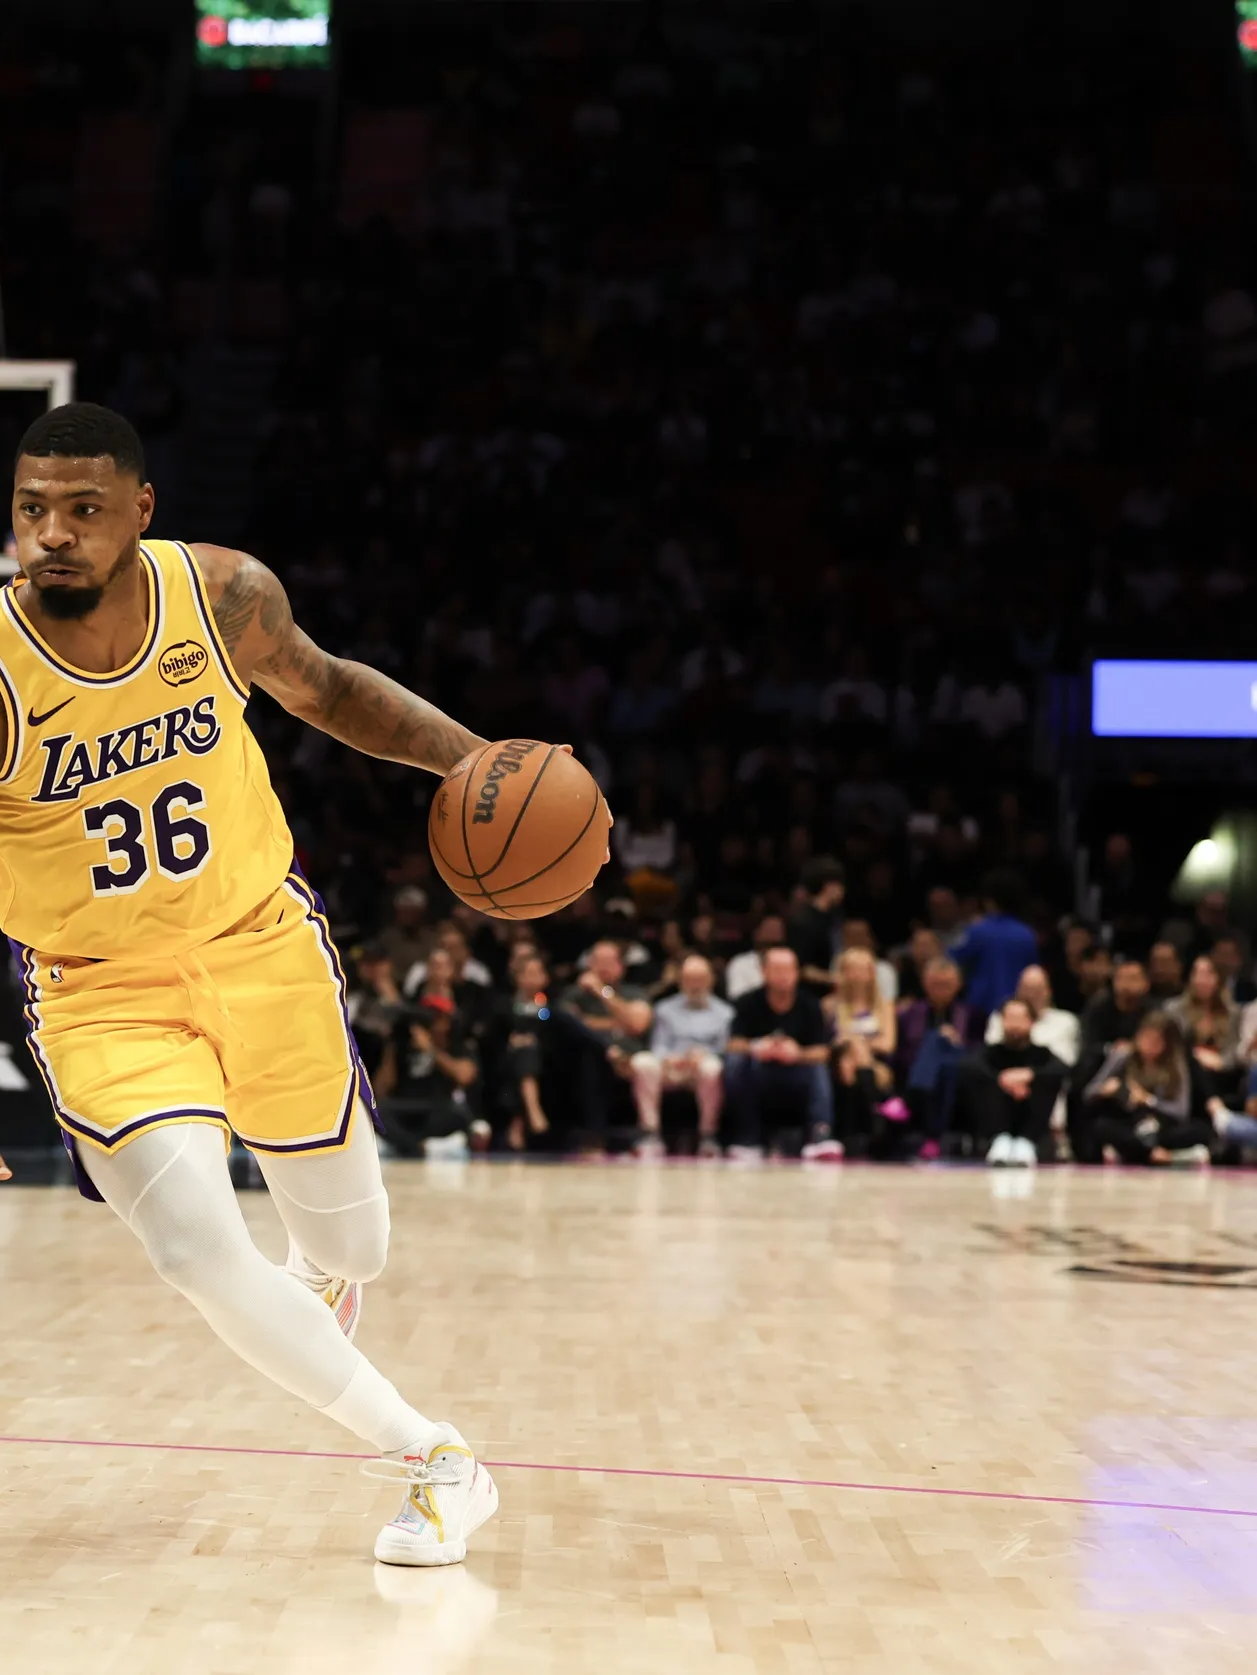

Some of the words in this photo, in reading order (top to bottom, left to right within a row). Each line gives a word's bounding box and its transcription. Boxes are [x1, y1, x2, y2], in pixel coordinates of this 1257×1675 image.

[162, 651, 204, 674] bibigo
[30, 695, 222, 803] LAKERS
[82, 779, 213, 898] 36
